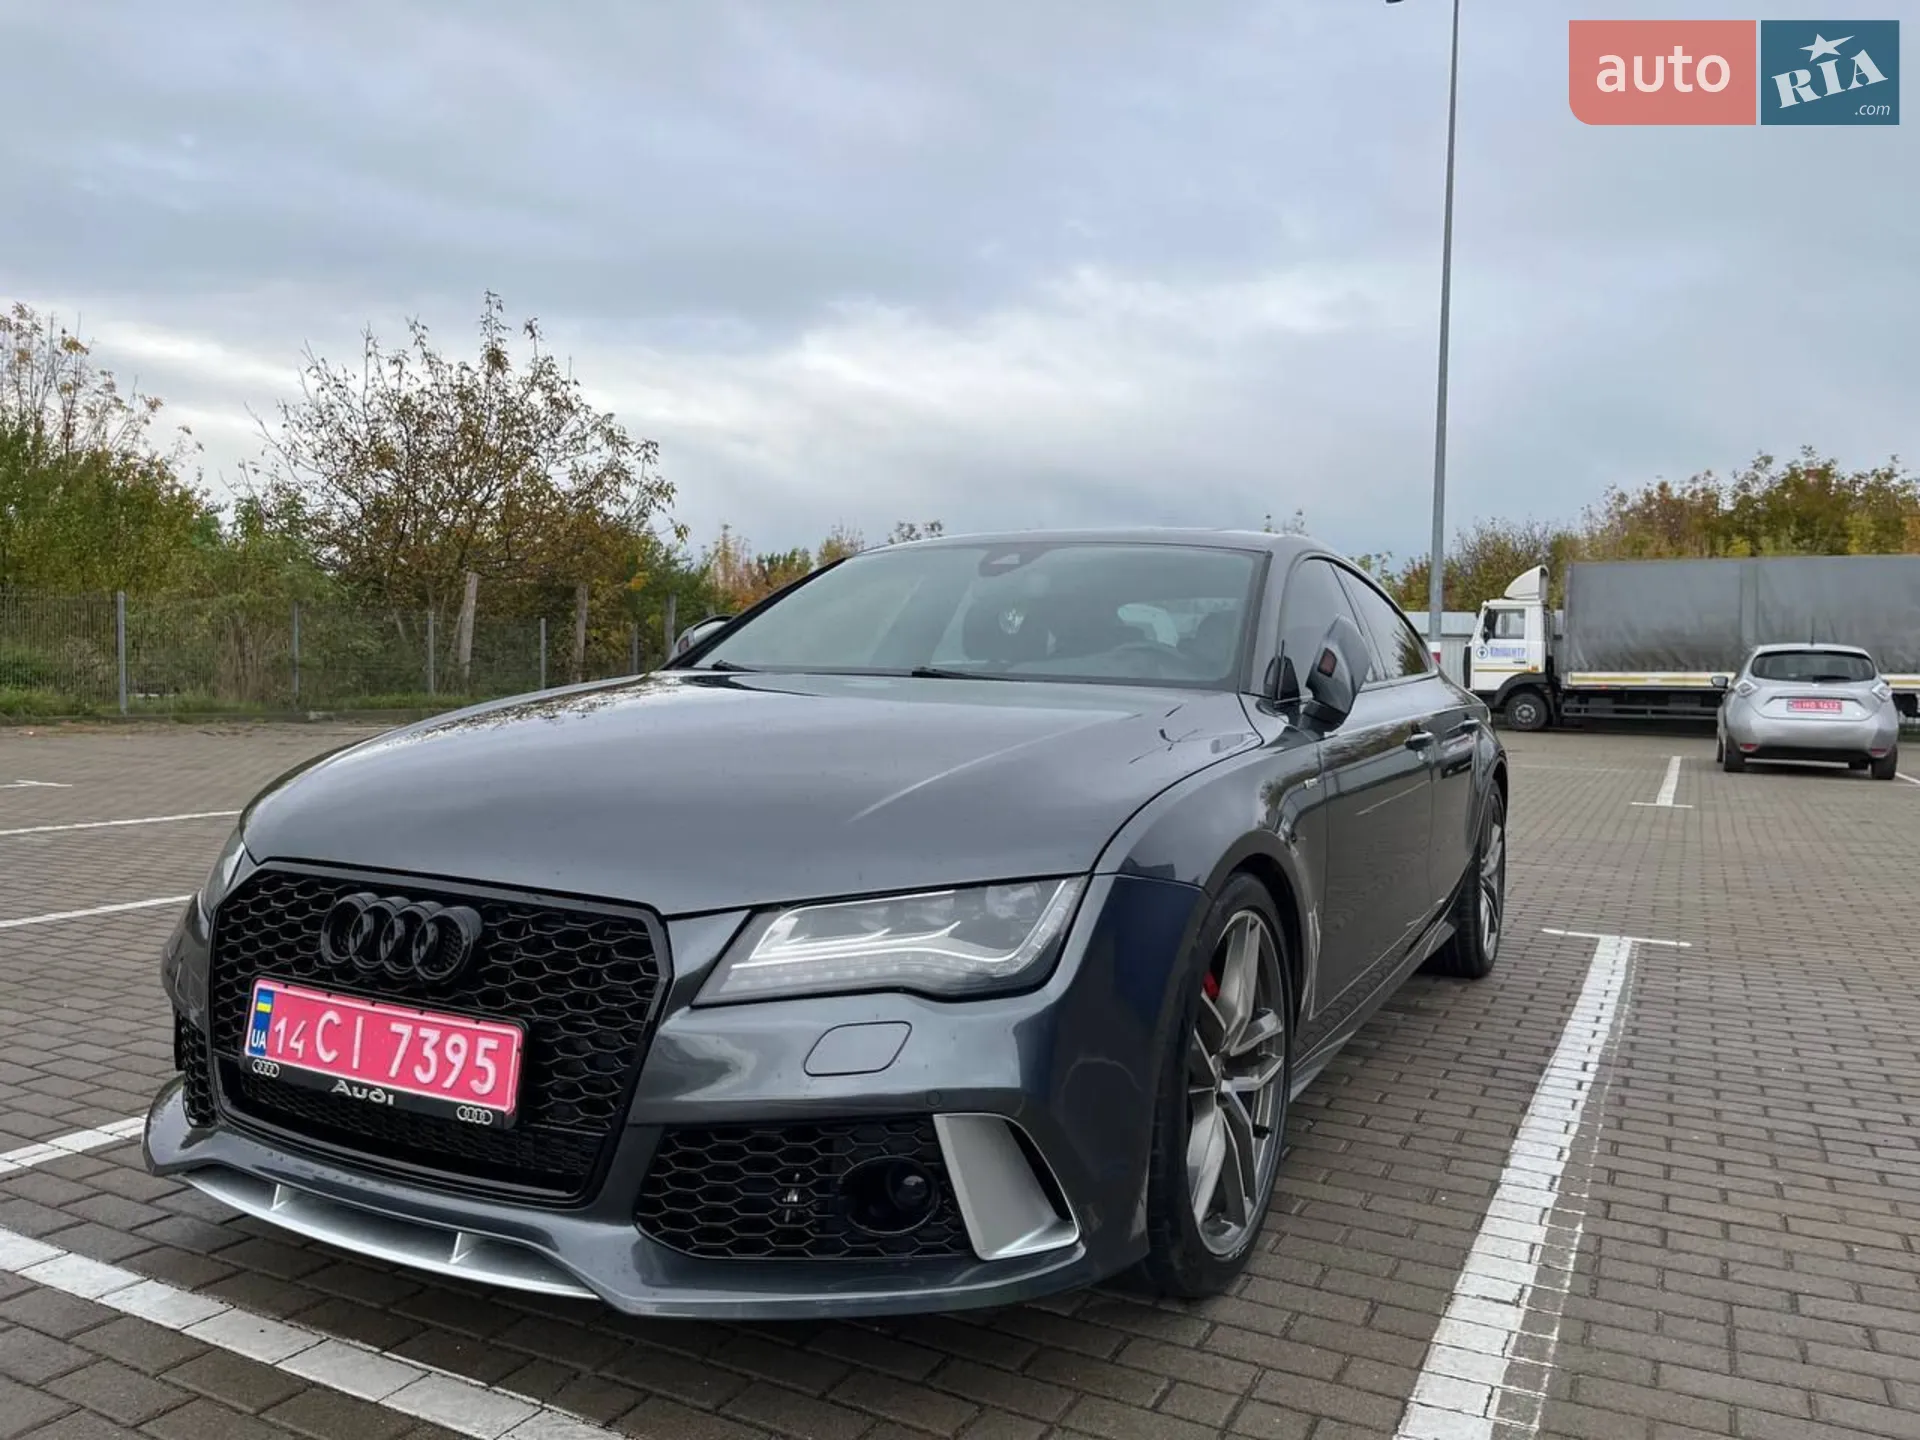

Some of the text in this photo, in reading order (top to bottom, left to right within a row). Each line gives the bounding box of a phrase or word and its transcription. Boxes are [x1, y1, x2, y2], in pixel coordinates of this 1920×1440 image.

[251, 1028, 267, 1049] UA
[388, 1023, 499, 1095] 7395
[330, 1079, 395, 1106] Audi
